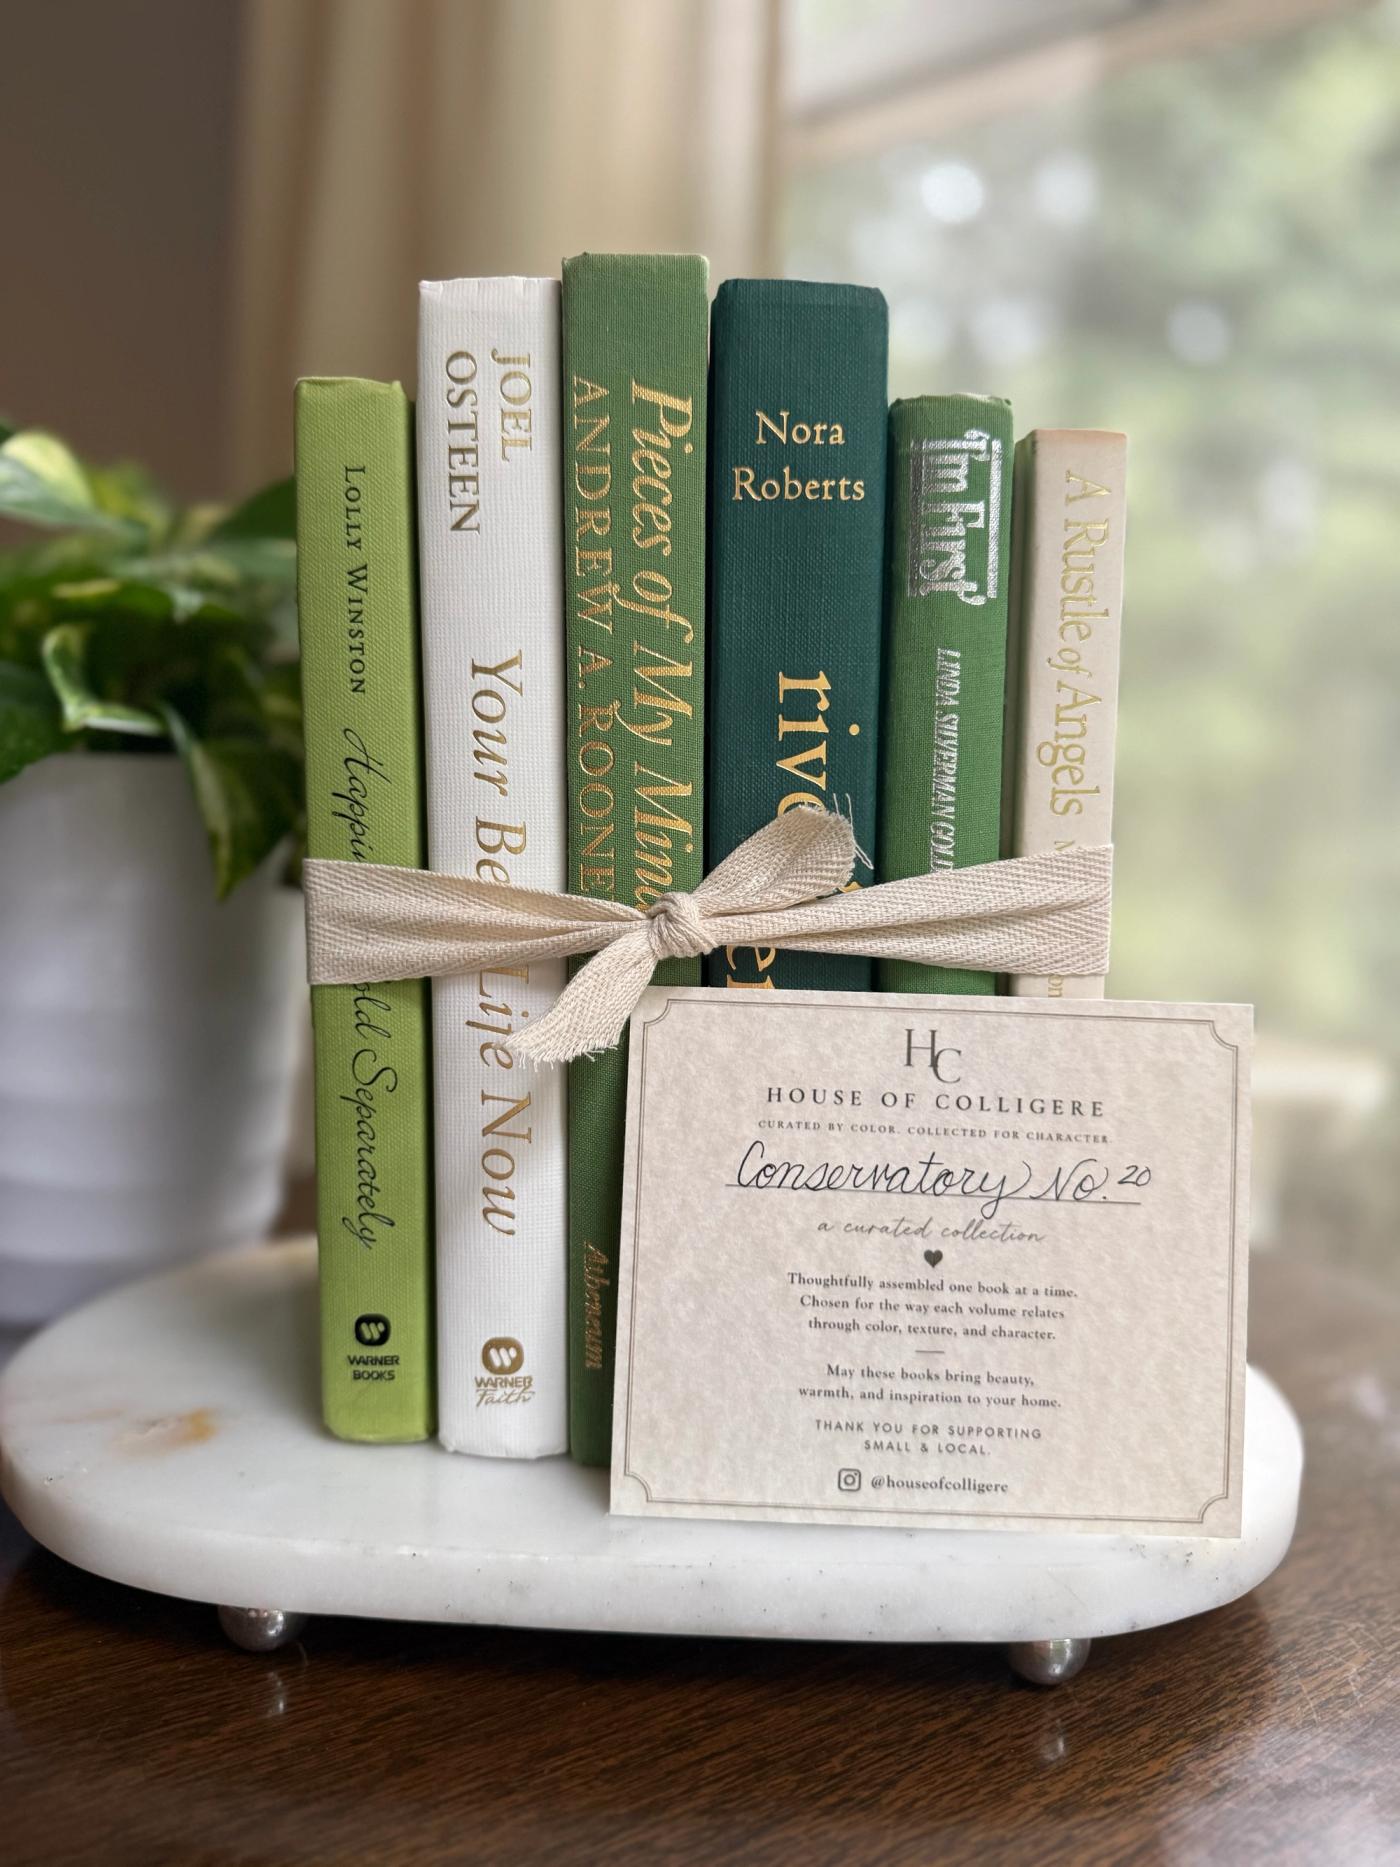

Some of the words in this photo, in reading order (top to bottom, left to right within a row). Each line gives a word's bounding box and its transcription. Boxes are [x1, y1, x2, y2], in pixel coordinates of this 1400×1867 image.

[491, 350, 533, 463] JOEL
[445, 350, 481, 535] OSTEEN
[755, 410, 846, 446] Nora
[631, 378, 694, 557] Pieces
[732, 466, 866, 502] Roberts
[1064, 469, 1112, 505] A
[344, 464, 366, 550] LOLLY
[573, 376, 614, 635] ANDREW
[1060, 517, 1111, 641] Rustle
[611, 572, 694, 645] of
[345, 563, 367, 695] WINSTON
[577, 648, 612, 688] A.
[935, 647, 961, 706] LINDA
[1046, 646, 1094, 679] of
[471, 648, 523, 793] Your
[612, 644, 693, 761] My
[931, 709, 960, 820] SILVERMAN
[1036, 679, 1104, 816] Angels
[579, 704, 615, 901] ROONE
[766, 1087, 862, 1106] HOUSE
[881, 1092, 916, 1109] OF
[935, 1094, 1104, 1118] COLLIGERE
[342, 1048, 397, 1252] Separately
[758, 1119, 821, 1131] CURATED
[828, 1122, 844, 1132] BY
[850, 1123, 901, 1135] COLOR.
[907, 1126, 987, 1138] COLLECTED
[994, 1130, 1020, 1140] FOR
[1026, 1131, 1113, 1145] CHARACTER.
[481, 1090, 532, 1236] Now
[736, 1140, 1032, 1220] Conservatory
[1029, 1158, 1109, 1201] No.
[1117, 1164, 1152, 1187] 20
[817, 1221, 834, 1233] a
[843, 1216, 934, 1239] curated
[940, 1218, 1046, 1243] collection
[787, 1272, 874, 1290] Thoughtfully
[879, 1278, 944, 1292] assembled
[949, 1283, 973, 1293] one
[977, 1280, 1010, 1294] book
[1015, 1286, 1028, 1296] at
[1032, 1288, 1039, 1296] a
[1044, 1286, 1078, 1298] time.
[800, 1294, 850, 1309] Chosen
[855, 1296, 874, 1310] for
[879, 1298, 900, 1312] the
[905, 1303, 930, 1319] way
[934, 1301, 963, 1314] each
[968, 1303, 1017, 1317] volume
[1021, 1306, 1065, 1319] relates
[808, 1317, 860, 1333] through
[865, 1319, 902, 1335] color,
[907, 1325, 958, 1337] texture,
[962, 1324, 987, 1337] and
[991, 1325, 1056, 1340] character.
[347, 1354, 400, 1366] WARNER
[352, 1369, 396, 1381] BOOKS
[826, 1363, 855, 1379] May
[861, 1365, 895, 1380] these
[900, 1367, 940, 1381] books
[945, 1369, 982, 1385] bring
[986, 1371, 1035, 1387] beauty,
[474, 1376, 534, 1388] WARNER
[475, 1386, 536, 1408] Faith
[798, 1386, 854, 1400] warmth,
[859, 1388, 884, 1401] and
[889, 1389, 962, 1405] inspiration
[967, 1393, 981, 1404] to
[986, 1395, 1017, 1408] your
[1021, 1394, 1062, 1408] home.
[815, 1419, 864, 1432] THANK
[872, 1422, 903, 1434] YOU
[912, 1423, 939, 1435] FOR
[947, 1425, 1042, 1439] SUPPORTING
[864, 1439, 910, 1452] SMALL
[920, 1442, 929, 1453] &
[937, 1443, 991, 1456] LOCAL.
[871, 1474, 1009, 1494] @houseofcolligere
